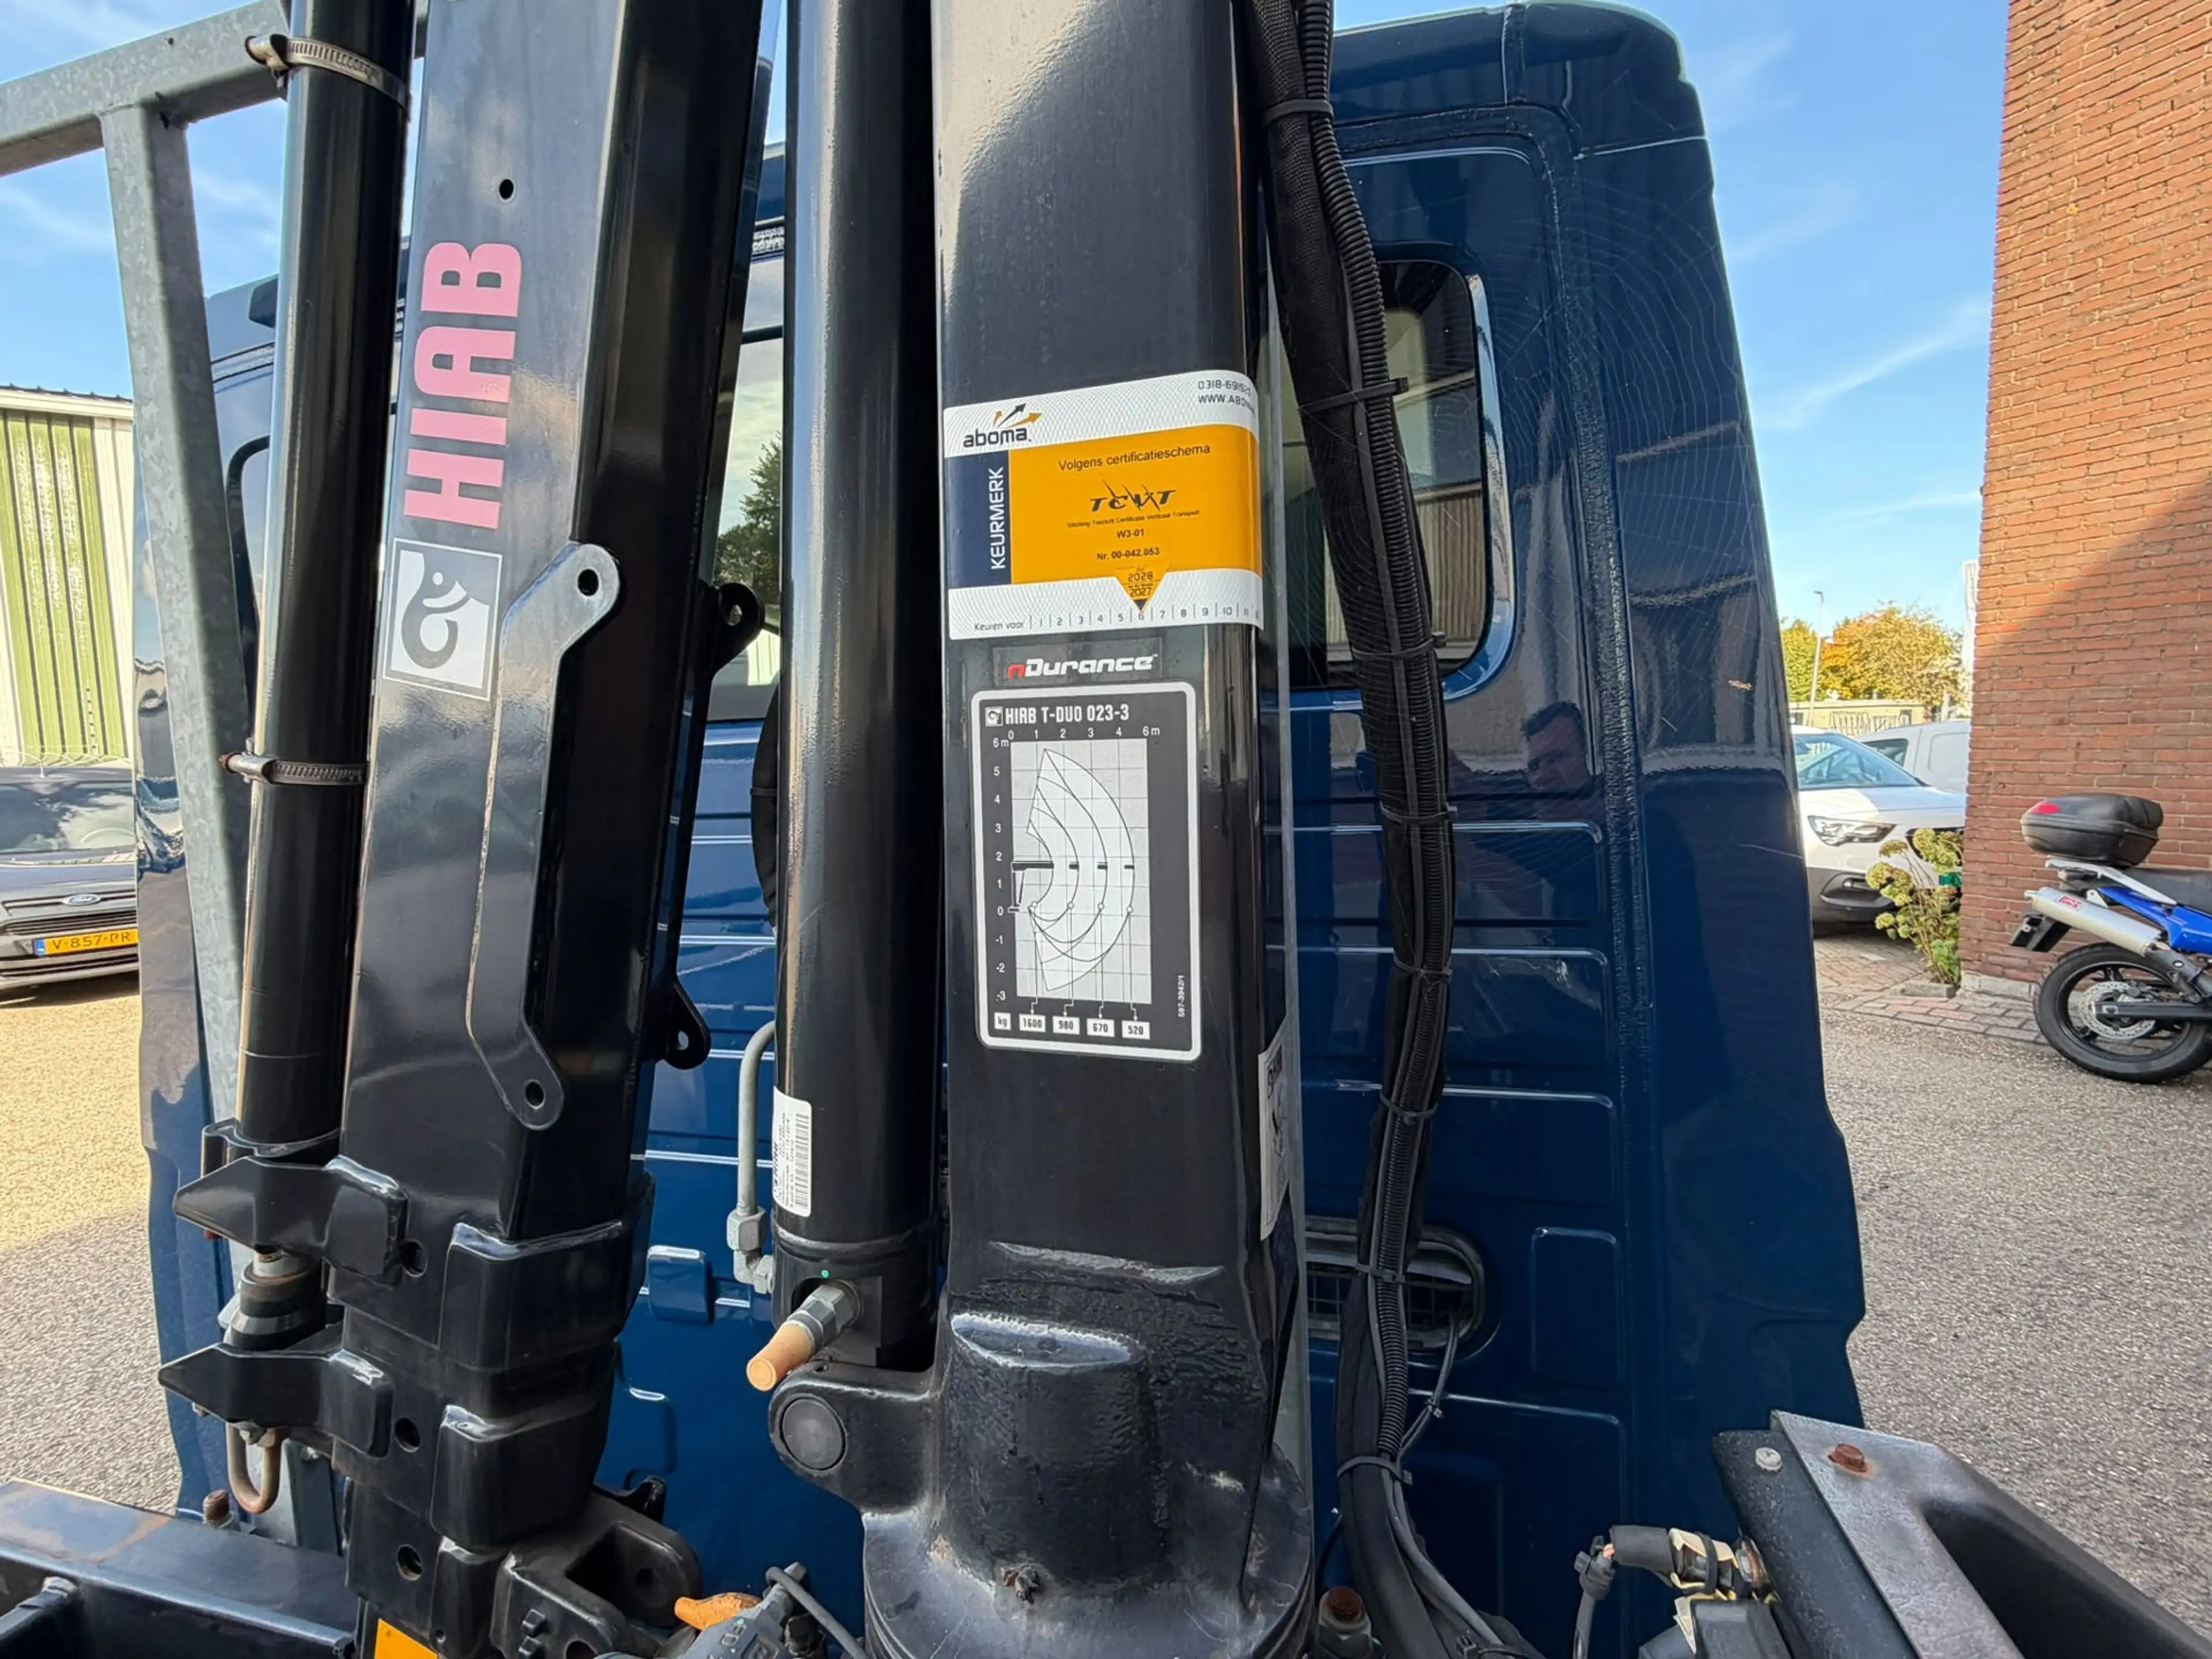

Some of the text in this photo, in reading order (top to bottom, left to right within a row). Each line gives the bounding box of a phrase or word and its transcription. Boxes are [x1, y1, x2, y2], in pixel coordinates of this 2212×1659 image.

[404, 242, 522, 529] HIAB
[963, 427, 1028, 448] aboma
[1058, 444, 1210, 472] Volgens certificatieschema
[988, 467, 1006, 570] KEURMERK
[1116, 529, 1145, 539] W3-01
[1111, 547, 1160, 559] 00-042.053
[1128, 571, 1153, 582] 2028
[1130, 588, 1152, 597] 2027
[975, 623, 1003, 631] Keuren
[1056, 617, 1063, 626] 2
[1078, 616, 1085, 625] 3
[1097, 613, 1104, 623] 4
[1118, 613, 1124, 622] 5
[1138, 611, 1145, 620] 6
[1160, 610, 1166, 619] 7
[1180, 608, 1187, 618] 8
[1202, 607, 1209, 616] 9
[1222, 606, 1233, 615] 10
[1007, 654, 1153, 679] nDurance
[1005, 703, 1130, 725] HIAB T-DUO 023-3
[1007, 730, 1014, 740] 0
[1034, 729, 1039, 738] 1
[1059, 728, 1066, 738] 2
[1088, 727, 1094, 737] 3
[1115, 726, 1122, 736] 4
[994, 766, 1000, 776] 5
[994, 794, 1001, 804] 4
[995, 823, 1002, 832] 3
[996, 852, 1002, 862] 2
[997, 880, 1002, 888] 1
[997, 906, 1003, 915] 0
[51, 932, 131, 950] V-857-PR
[995, 935, 1003, 944] -1
[995, 963, 1005, 973] -2
[998, 1017, 1007, 1027] kg
[1023, 1018, 1042, 1028] 1600
[1128, 1026, 1143, 1035] 520
